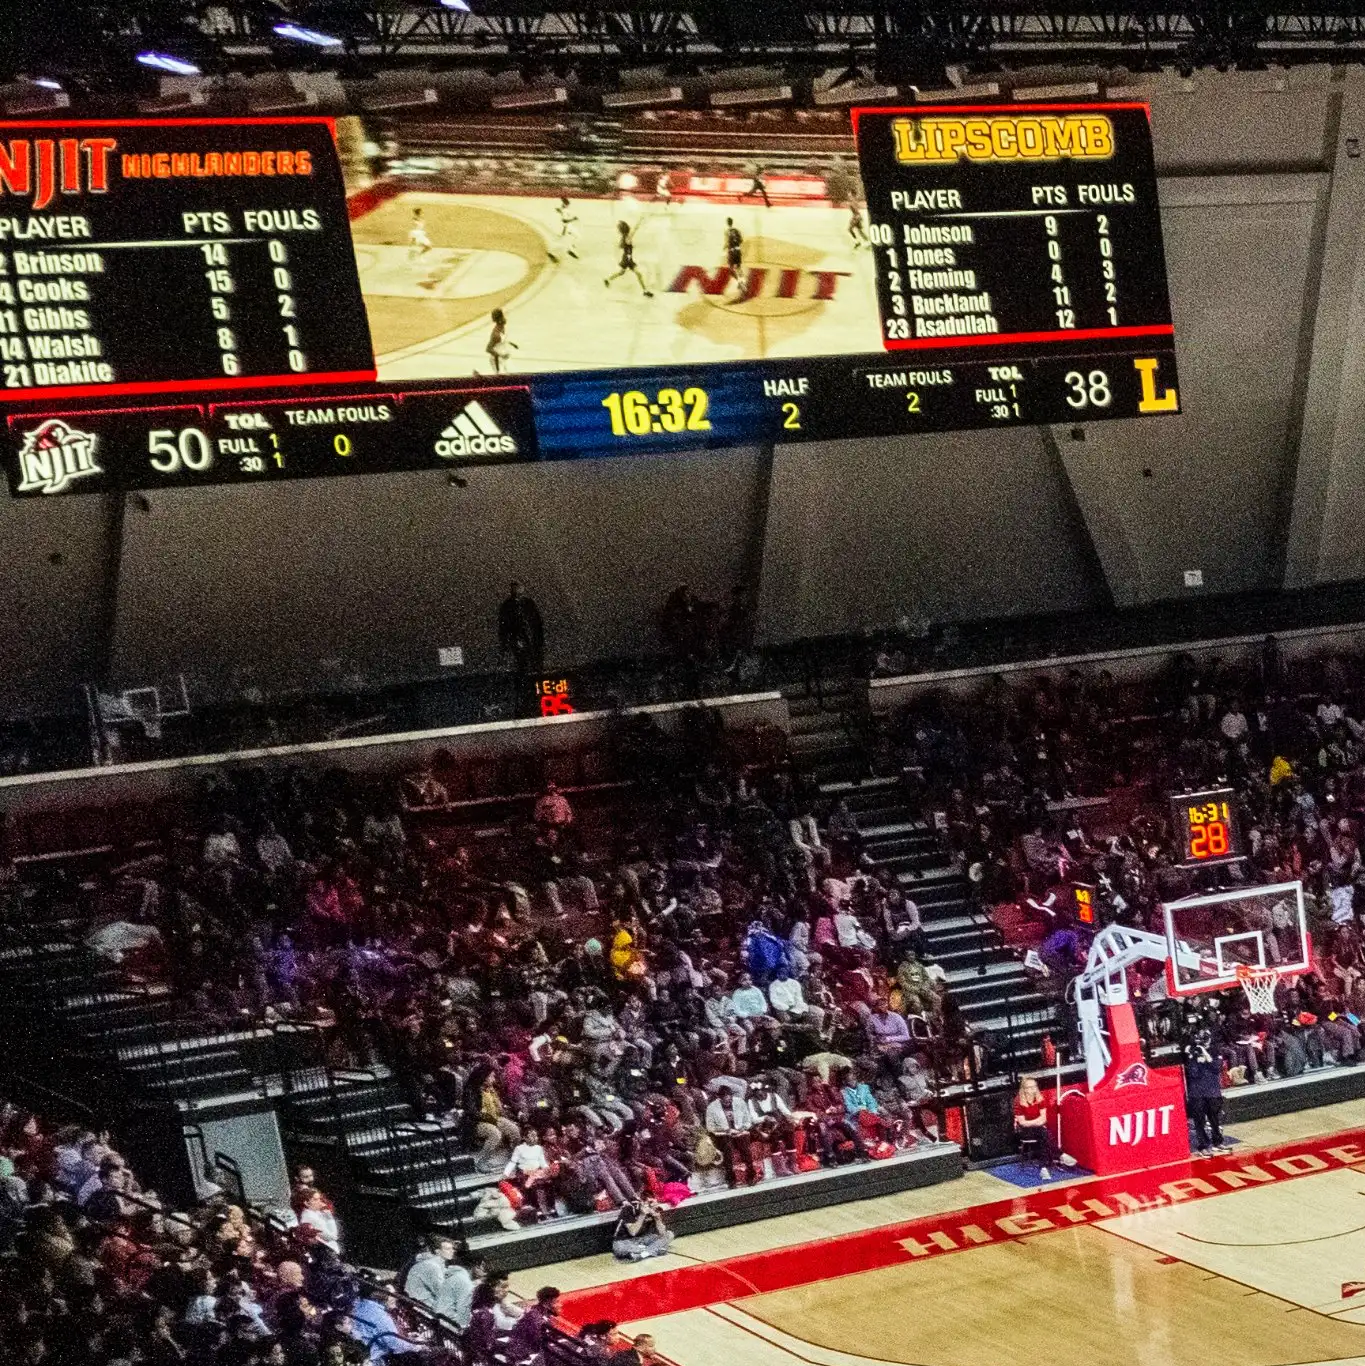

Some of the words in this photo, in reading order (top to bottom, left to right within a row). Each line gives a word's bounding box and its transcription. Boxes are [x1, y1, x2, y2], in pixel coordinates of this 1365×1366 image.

[892, 115, 1115, 163] LIPSCOMB
[0, 137, 117, 210] NJIT
[121, 151, 313, 179] HIGHLANDERS
[891, 189, 962, 210] PLAYER
[1031, 186, 1068, 204] PTS
[1078, 184, 1135, 202] FOULS
[0, 215, 92, 239] PLAYER
[182, 212, 232, 233] PTS
[244, 208, 321, 231] FOULS
[870, 223, 893, 245] 00
[903, 223, 973, 244] Johnson
[1045, 216, 1057, 236] 9
[1097, 215, 1108, 234] 2
[13, 250, 104, 275] Brinson
[201, 243, 228, 266] 14
[268, 240, 287, 262] 0
[887, 249, 898, 268] 1
[906, 246, 956, 267] Jones
[1048, 240, 1061, 260] 0
[1100, 238, 1112, 257] 0
[18, 277, 91, 303] Cooks
[205, 271, 234, 293] 15
[273, 268, 291, 290] 0
[889, 271, 901, 292] 2
[909, 268, 976, 290] Fleming
[1051, 264, 1063, 284] 4
[1103, 260, 1115, 280] 3
[24, 307, 91, 332] Gibbs
[212, 298, 230, 320] 5
[278, 295, 296, 317] 2
[892, 294, 905, 316] 3
[913, 291, 992, 316] Buckland
[1053, 286, 1071, 306] 11
[1105, 283, 1117, 302] 2
[887, 319, 911, 339] 23
[916, 312, 999, 338] Asadullah
[1056, 308, 1076, 329] 12
[1107, 306, 1119, 326] 1
[0, 337, 27, 361] 14
[27, 334, 102, 359] Walsh
[217, 327, 233, 350] 8
[283, 325, 300, 347] 1
[4, 363, 33, 388] 21
[34, 360, 117, 386] Diakite
[222, 353, 241, 376] 6
[288, 349, 306, 373] 0
[866, 372, 907, 388] TEAM
[908, 369, 954, 386] FOULS
[987, 366, 1025, 381] TOL
[763, 377, 810, 398] HALF
[975, 387, 1007, 403] FULL
[1010, 384, 1018, 398] 1
[1064, 370, 1112, 408] 38
[1134, 358, 1179, 413] L
[285, 408, 334, 426] TEAM
[338, 404, 390, 422] FOULS
[602, 386, 711, 436] 16:32
[782, 403, 801, 429] 2
[906, 392, 921, 413] 2
[990, 404, 1010, 419] :30
[1012, 402, 1020, 417] 1
[225, 412, 272, 430] TOL
[149, 427, 210, 472] 50
[218, 437, 260, 455] FULL
[269, 433, 279, 449] 1
[333, 433, 352, 457] 0
[434, 432, 517, 457] adidas
[20, 440, 100, 493] NJIT
[238, 456, 264, 473] :30
[273, 451, 285, 468] 1
[1188, 802, 1229, 824] 16:31
[1189, 821, 1230, 859] 28
[1109, 1104, 1175, 1147] NJIT
